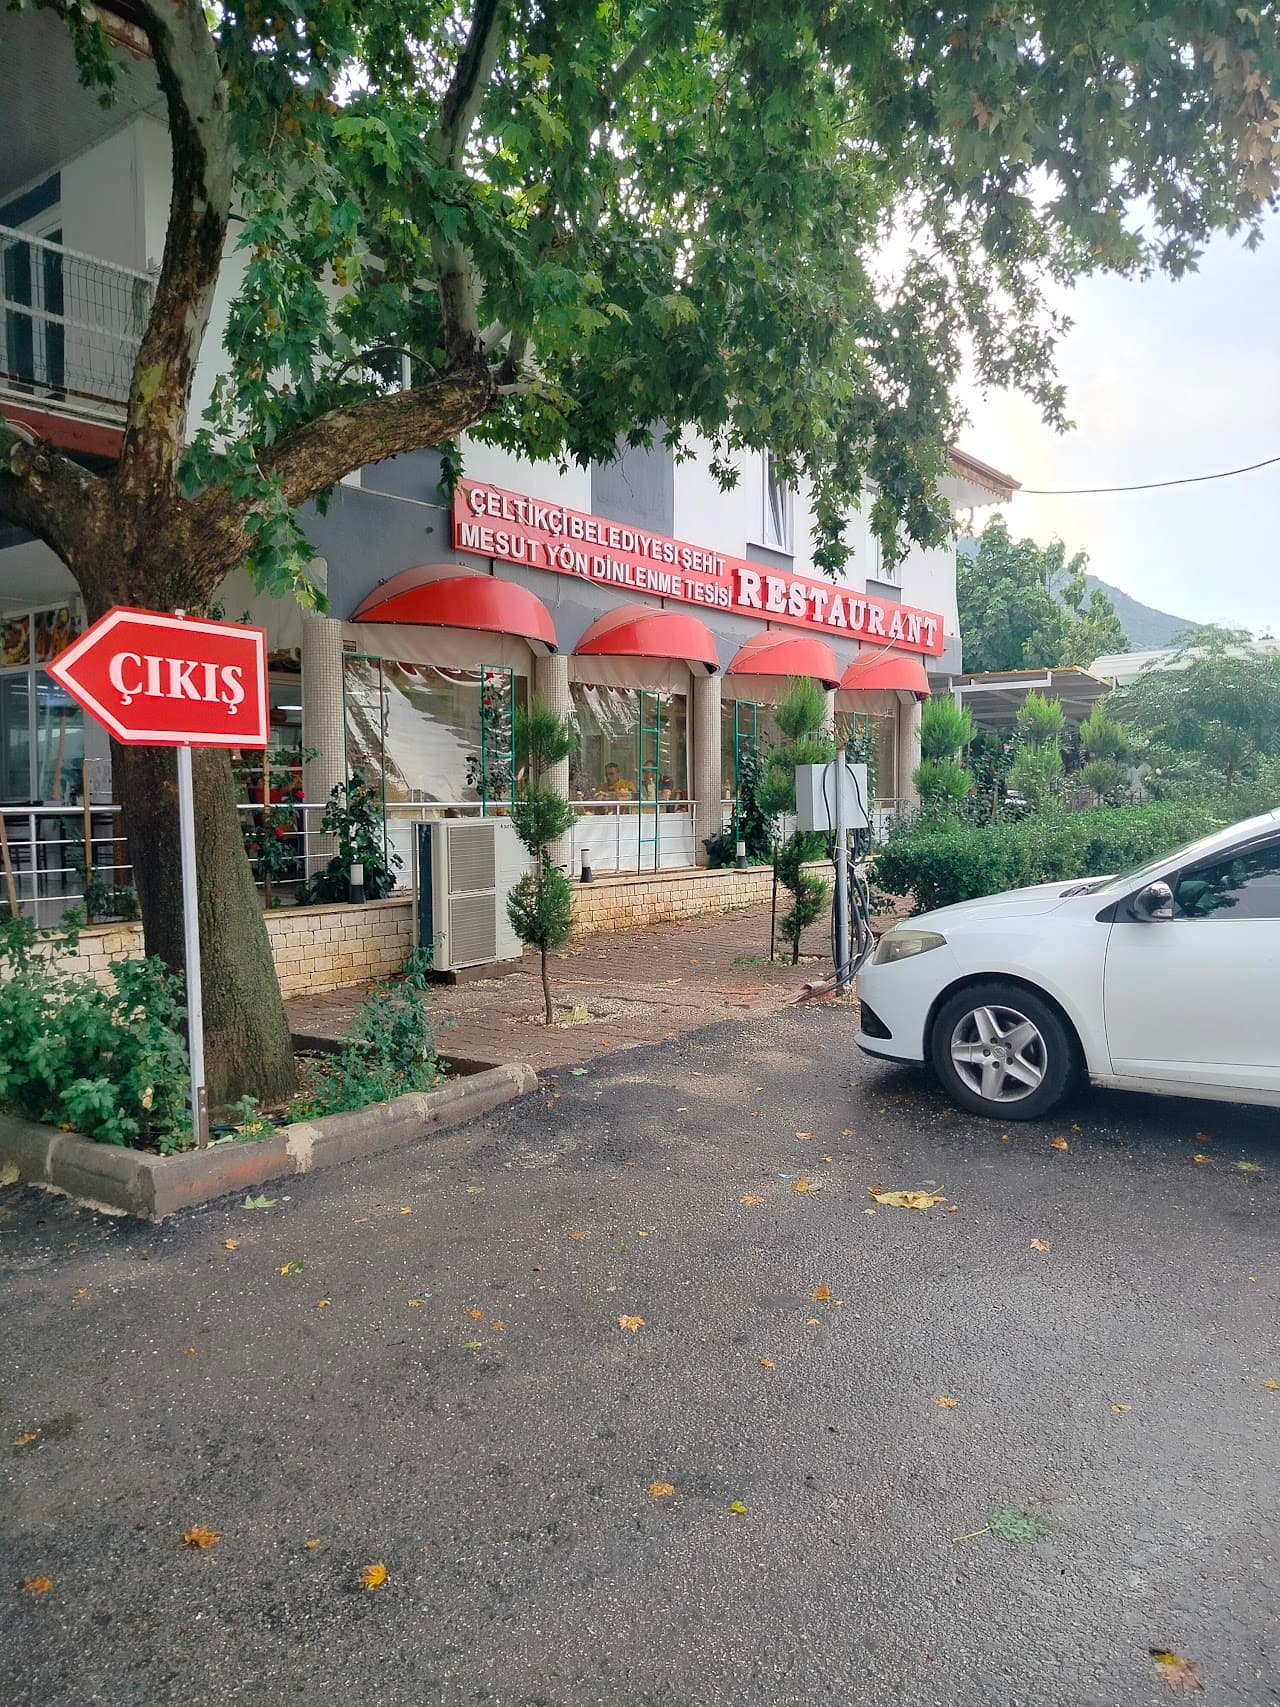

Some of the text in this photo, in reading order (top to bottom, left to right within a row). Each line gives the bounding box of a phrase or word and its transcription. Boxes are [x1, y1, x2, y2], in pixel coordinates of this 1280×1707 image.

[461, 522, 732, 607] MESUT YÖN DİNLENME TESİSİ
[470, 487, 568, 537] ÇELTİKÇİ
[682, 551, 726, 577] ŞEHİT
[737, 567, 938, 647] RESTAURANT
[109, 652, 245, 715] ÇIKIŞ
